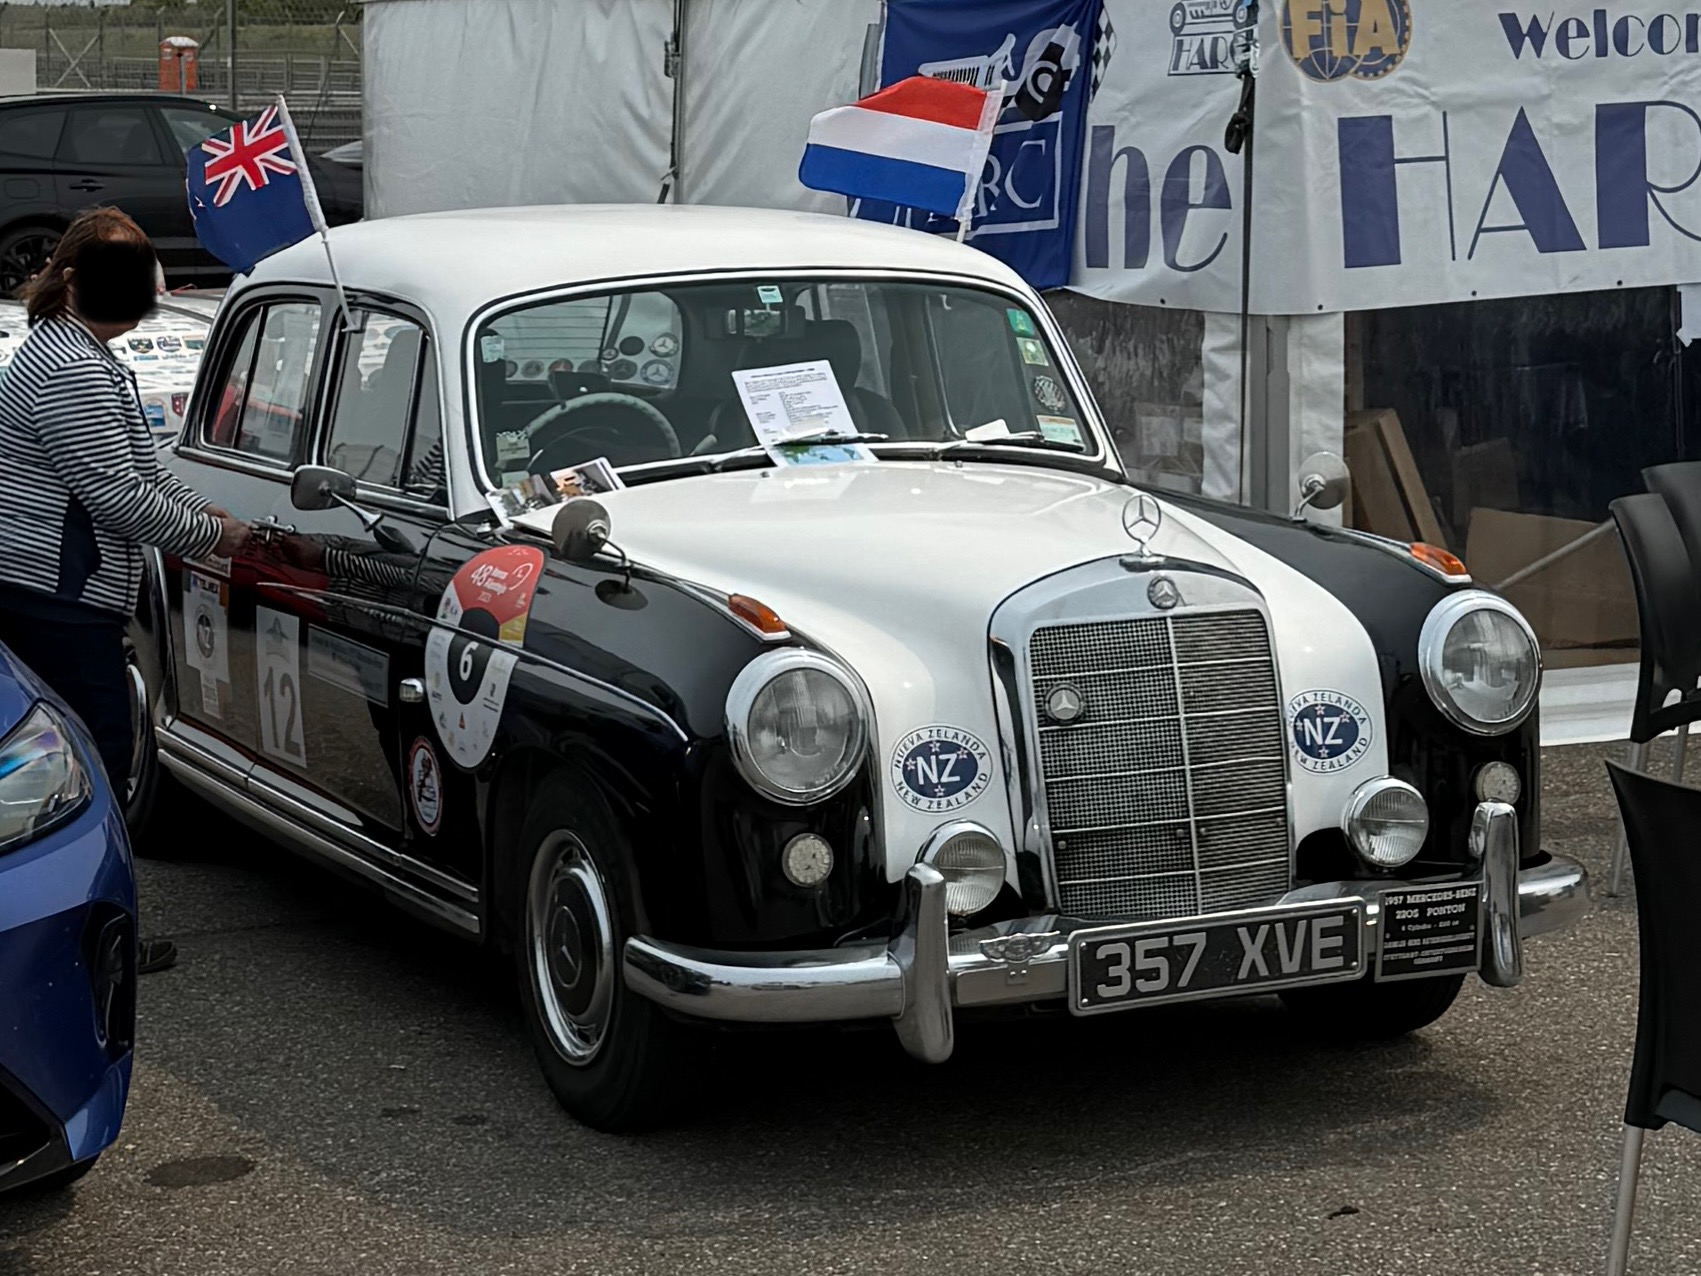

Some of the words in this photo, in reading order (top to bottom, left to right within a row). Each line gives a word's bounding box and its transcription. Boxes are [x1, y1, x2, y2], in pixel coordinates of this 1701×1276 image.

[459, 640, 479, 681] 6
[1313, 693, 1367, 725] ZELANDA
[1303, 716, 1343, 746] NZ
[894, 733, 923, 769] NUEVA
[928, 729, 986, 760] ZELANDA
[1312, 738, 1368, 770] ZEALAND
[916, 753, 961, 785] NZ
[896, 781, 921, 806] NEW
[927, 772, 988, 809] ZEALAND
[1096, 931, 1207, 998] 357
[1236, 915, 1345, 981] XVE
